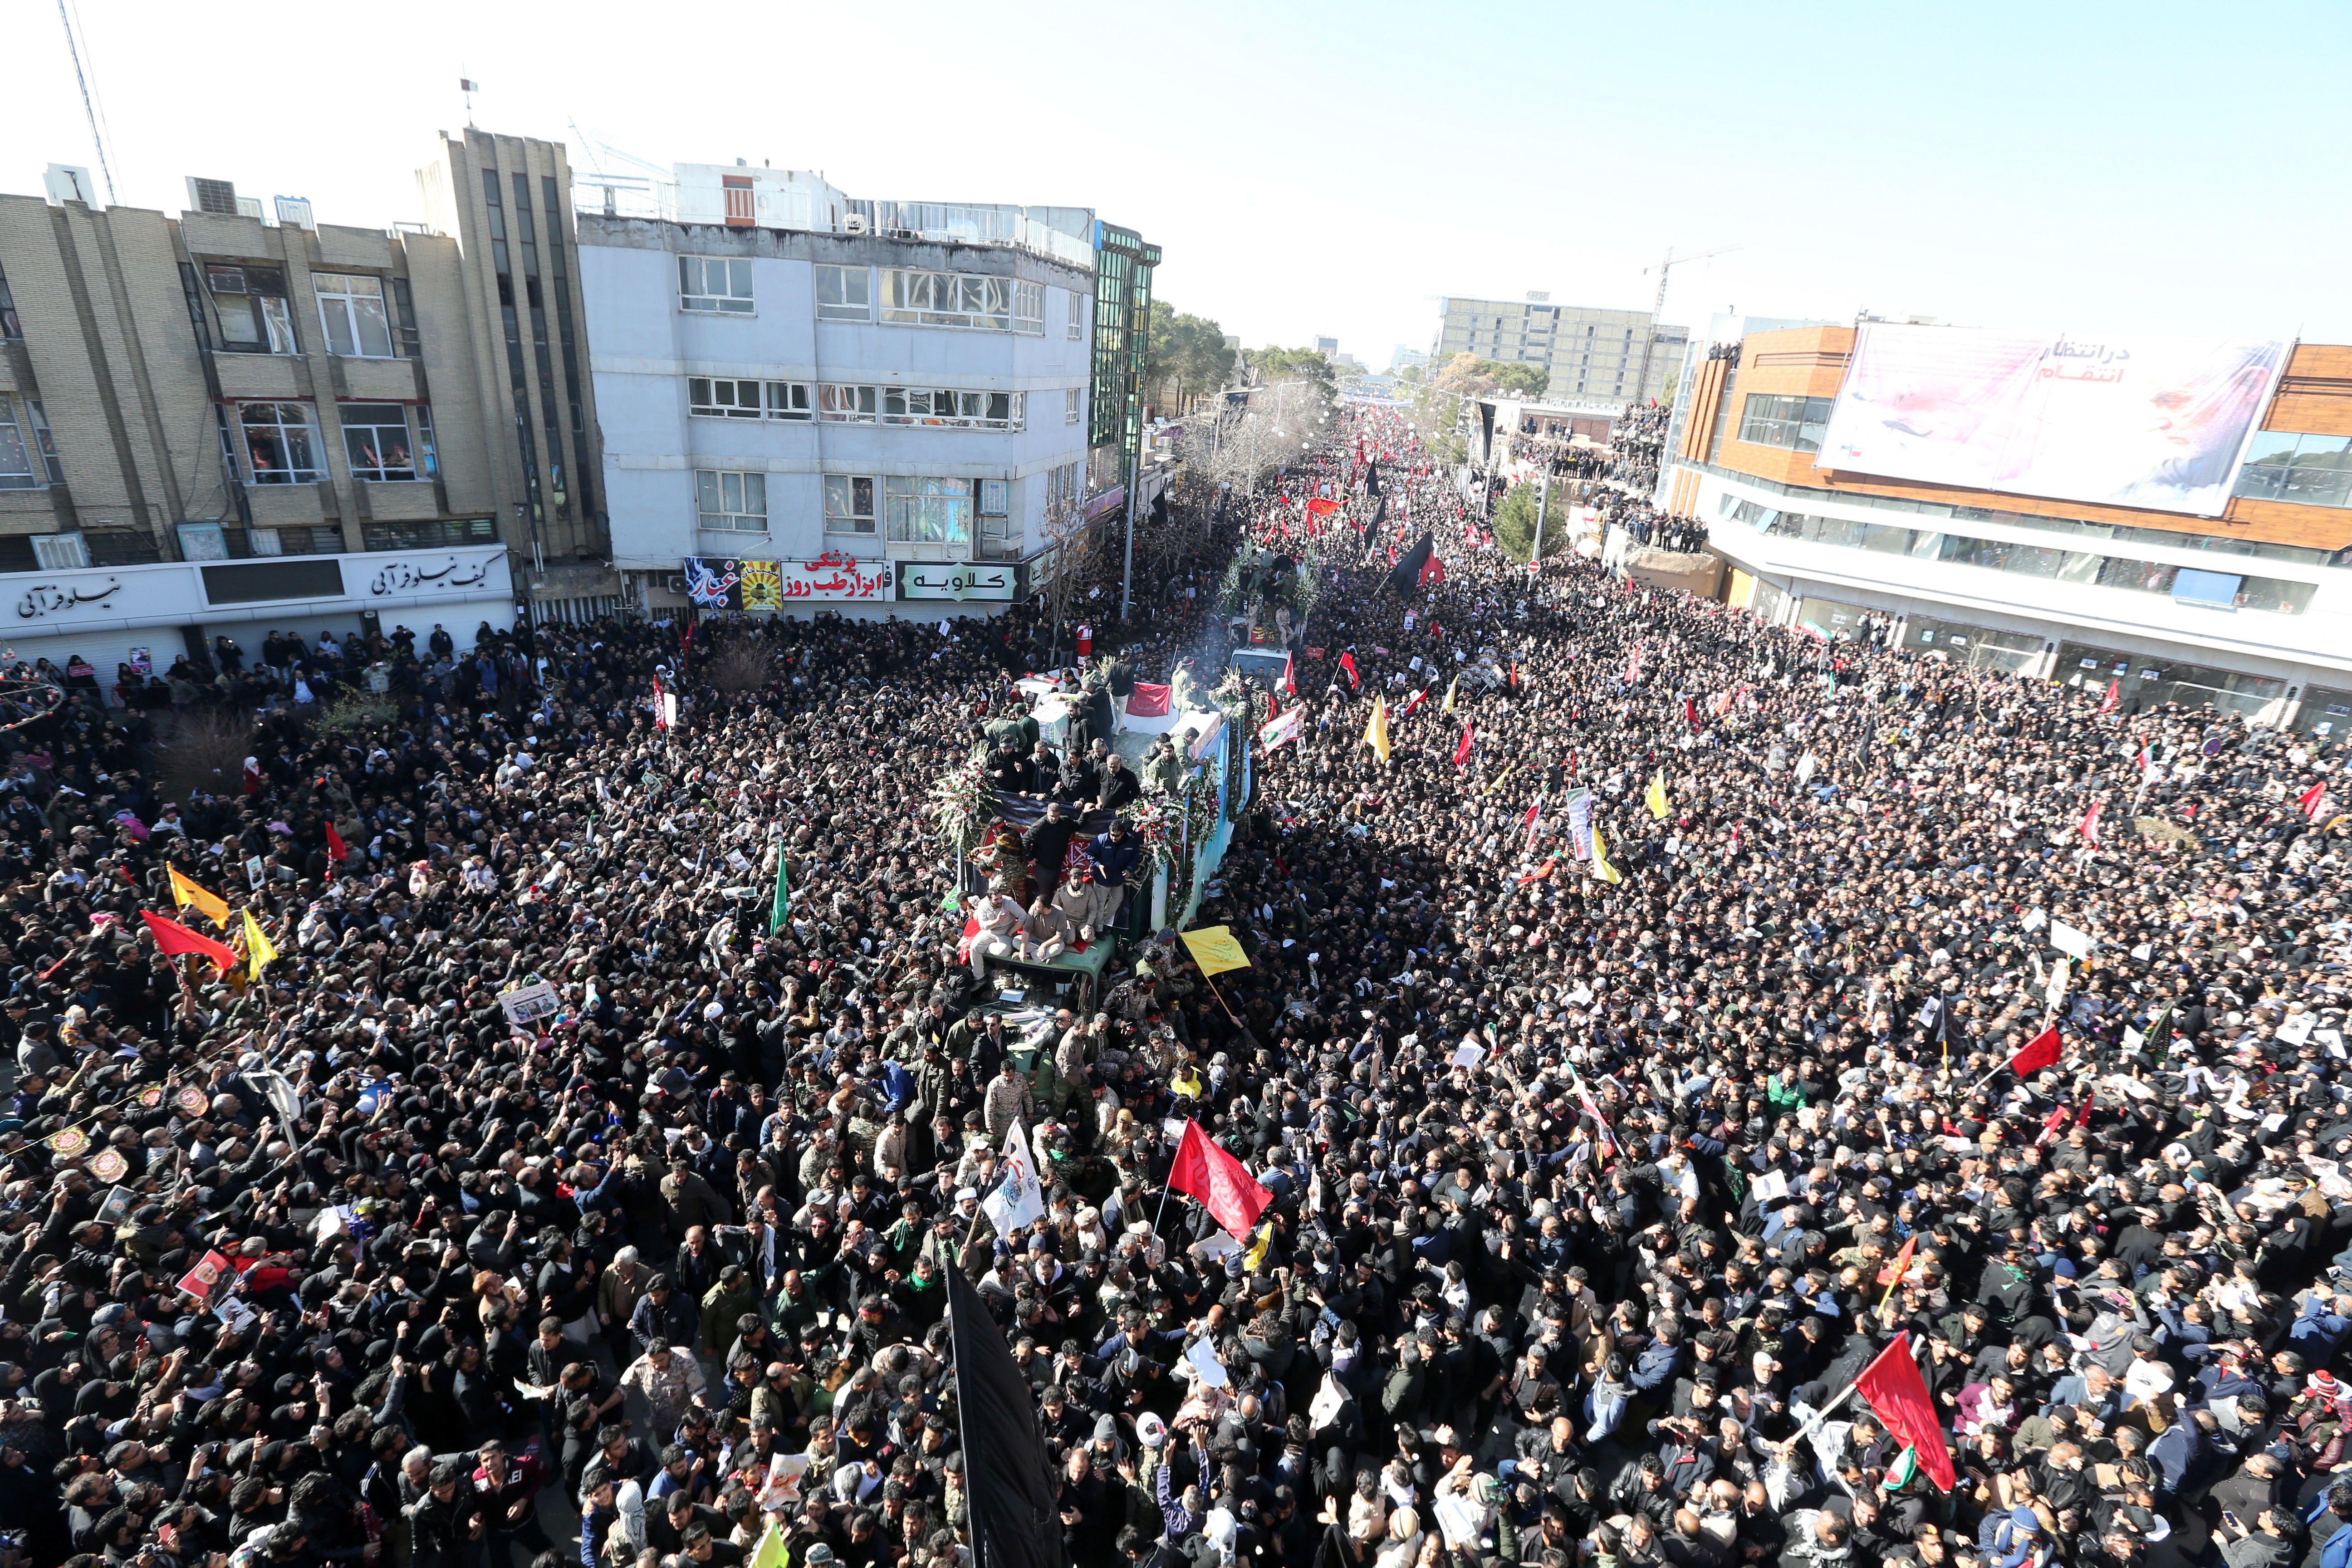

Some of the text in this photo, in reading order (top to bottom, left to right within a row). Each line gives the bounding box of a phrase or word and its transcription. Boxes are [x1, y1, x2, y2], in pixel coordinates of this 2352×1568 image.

[2038, 341, 2131, 364] در انتظار
[2035, 365, 2125, 383] انتقام
[372, 552, 504, 595] کیف نیلوفر آبی
[804, 549, 856, 576] پزشکی
[689, 561, 740, 606] غبار
[783, 576, 811, 597] روز
[813, 572, 847, 597] طب
[845, 573, 882, 597] ابزار
[913, 572, 1005, 591] کلاویه
[19, 577, 120, 618] نیلوفر آبی
